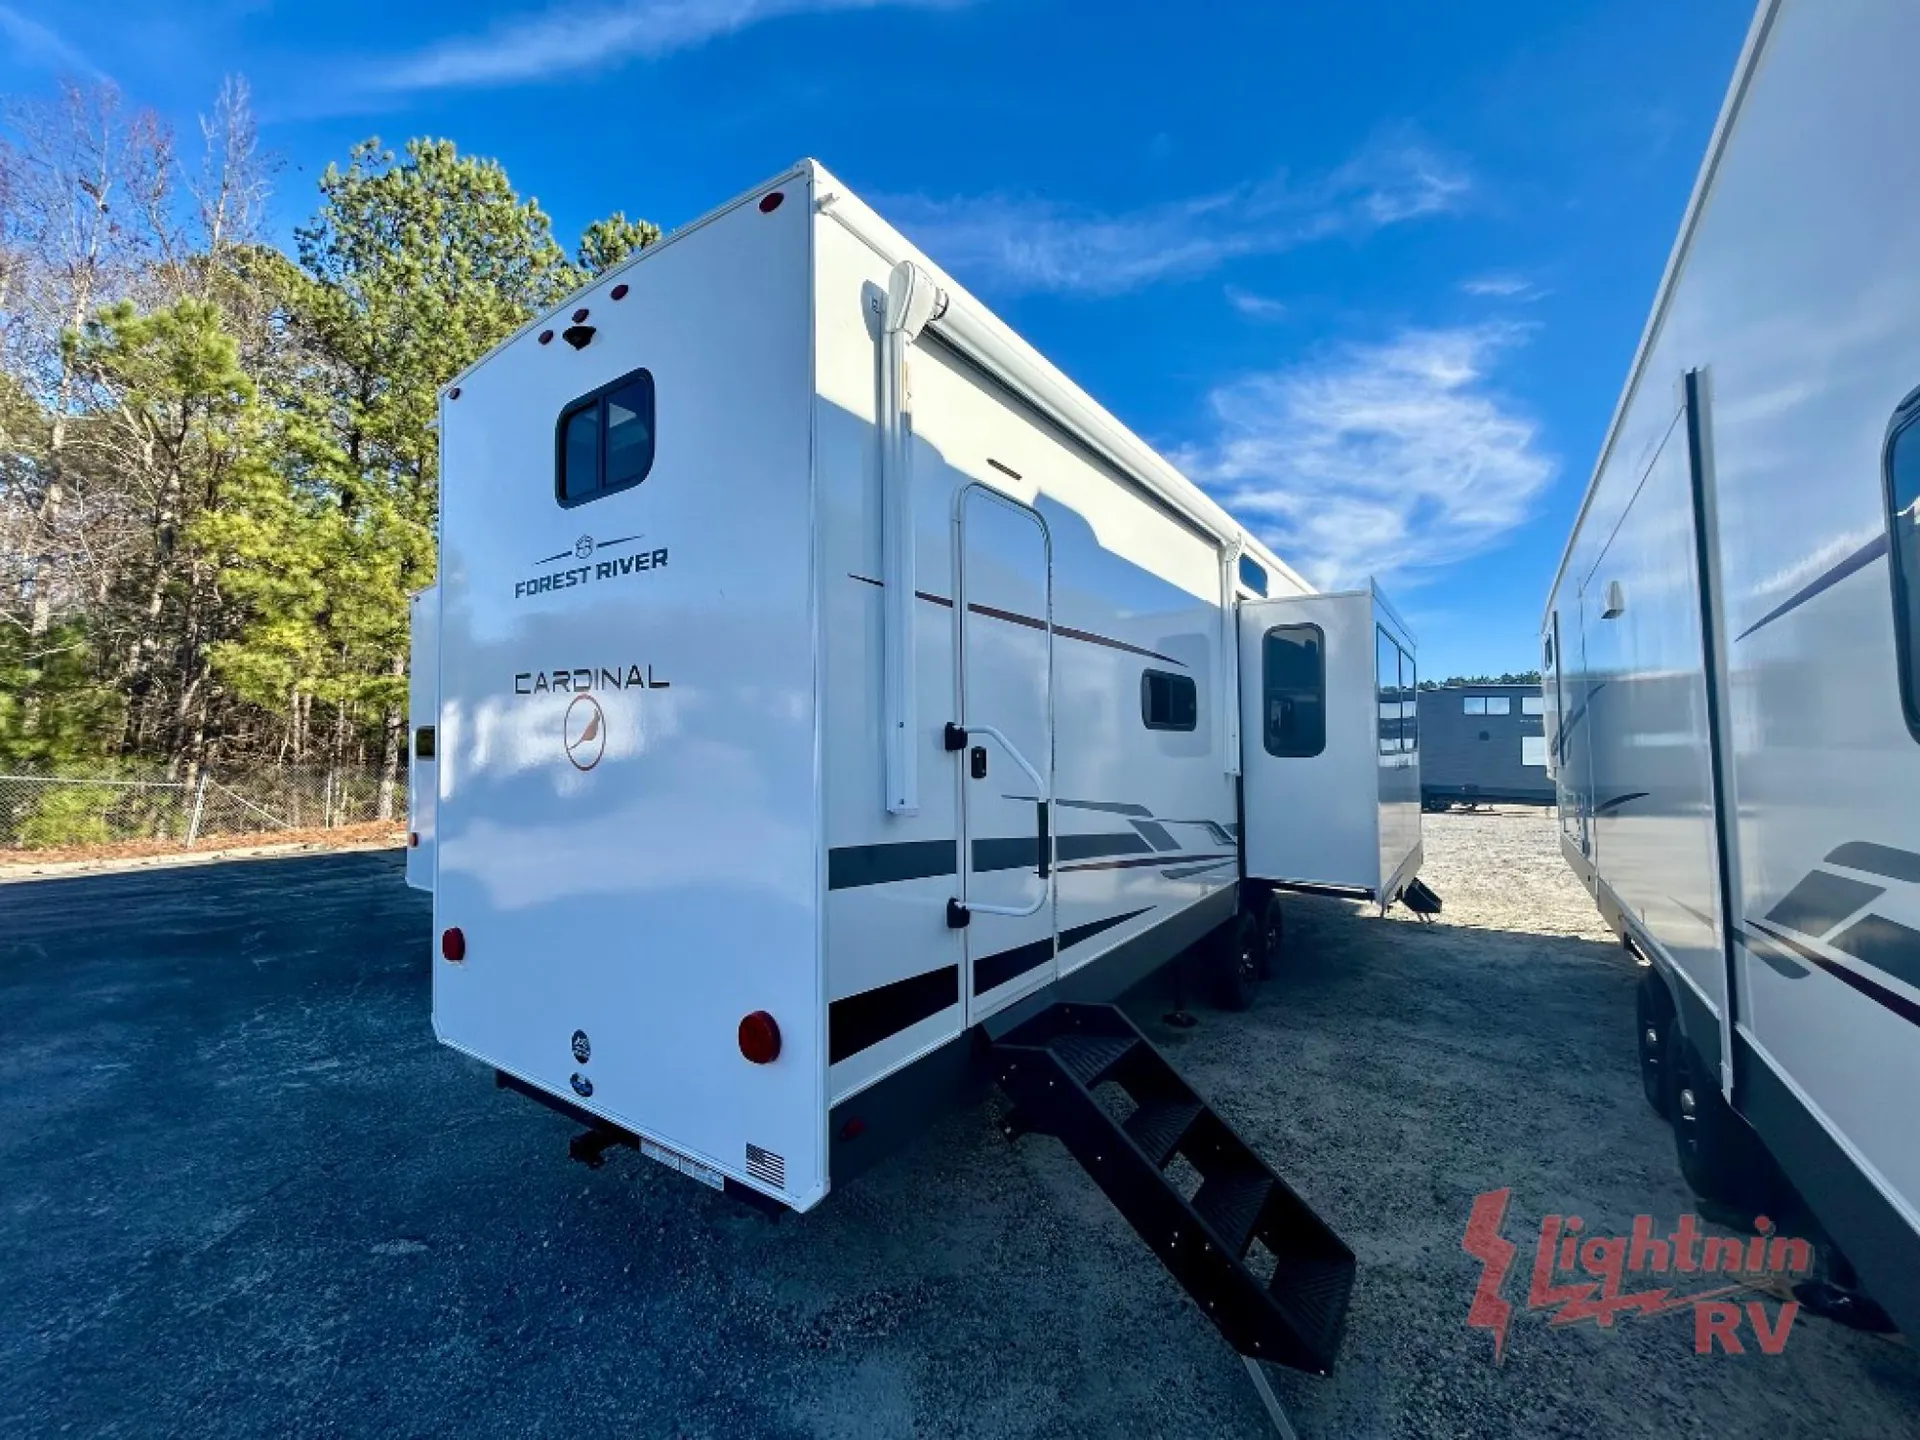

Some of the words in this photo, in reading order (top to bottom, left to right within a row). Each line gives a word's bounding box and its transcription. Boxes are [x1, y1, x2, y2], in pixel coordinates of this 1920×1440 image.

[514, 566, 591, 599] FOREST
[596, 548, 668, 581] RIVER
[514, 664, 670, 694] CARDINAL
